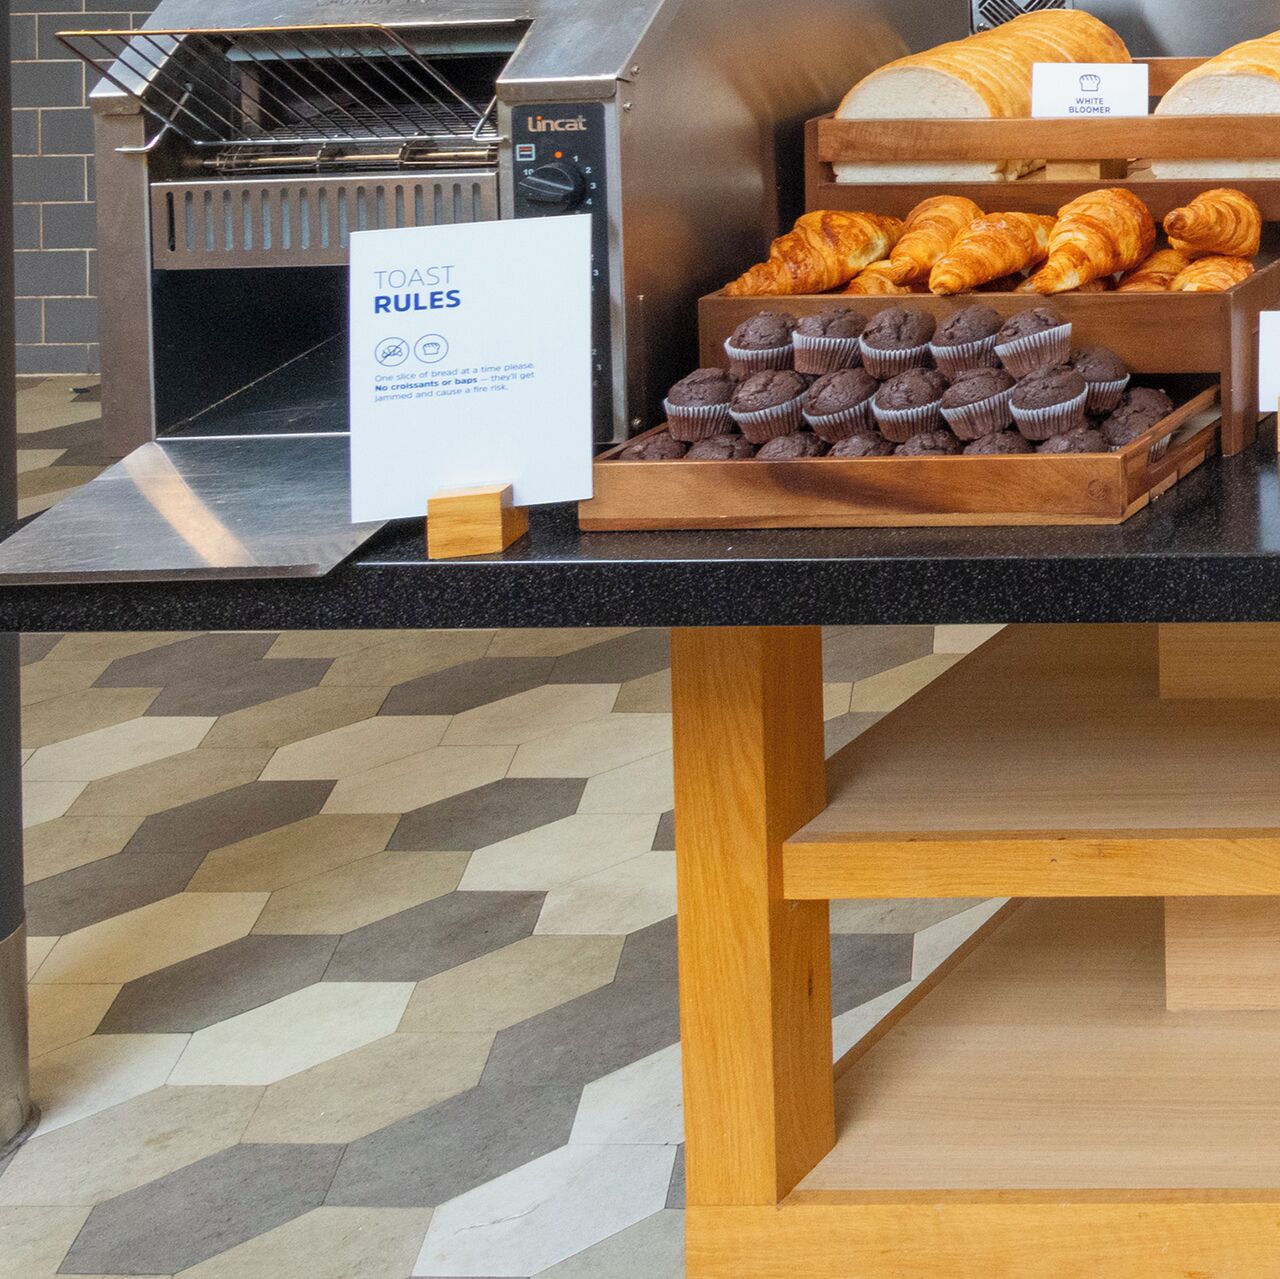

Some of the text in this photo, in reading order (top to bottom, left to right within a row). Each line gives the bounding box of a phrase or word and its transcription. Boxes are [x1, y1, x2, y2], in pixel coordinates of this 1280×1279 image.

[1068, 106, 1111, 114] BLOOMER
[1075, 97, 1104, 105] WHITE
[373, 265, 455, 289] TOAST
[374, 289, 461, 314] RULES
[374, 373, 394, 383] One
[396, 371, 416, 381] slice
[419, 370, 428, 379] of
[431, 368, 458, 378] bread
[481, 364, 502, 373] time
[374, 383, 389, 392] No
[391, 379, 439, 391] croissants
[454, 376, 478, 386] baps
[491, 372, 517, 383] they'll
[520, 371, 535, 381] get
[374, 392, 413, 403] jammed
[415, 390, 434, 398] and
[436, 388, 462, 396] cause
[473, 384, 488, 393] fire
[491, 383, 508, 392] risk.
